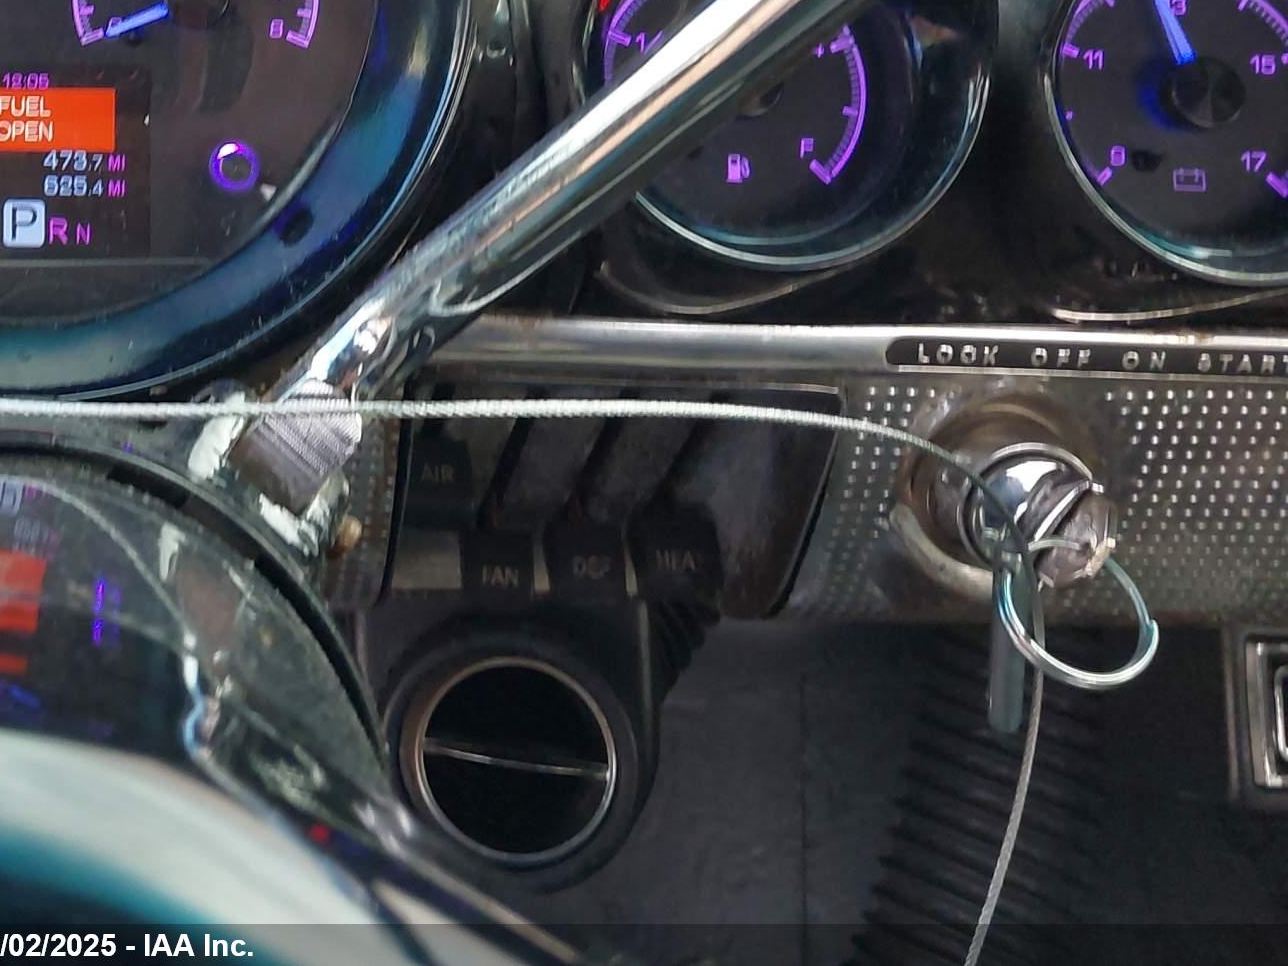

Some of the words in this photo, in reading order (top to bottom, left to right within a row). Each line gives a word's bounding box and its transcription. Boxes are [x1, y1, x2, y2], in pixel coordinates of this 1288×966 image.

[1083, 49, 1104, 70] 11
[108, 154, 125, 171] MI
[1241, 151, 1266, 171] 17
[108, 180, 125, 196] MI
[48, 217, 68, 245] R
[76, 223, 91, 245] N
[1031, 346, 1091, 369] OFF
[1122, 350, 1166, 371] ON
[421, 464, 454, 482] AIR
